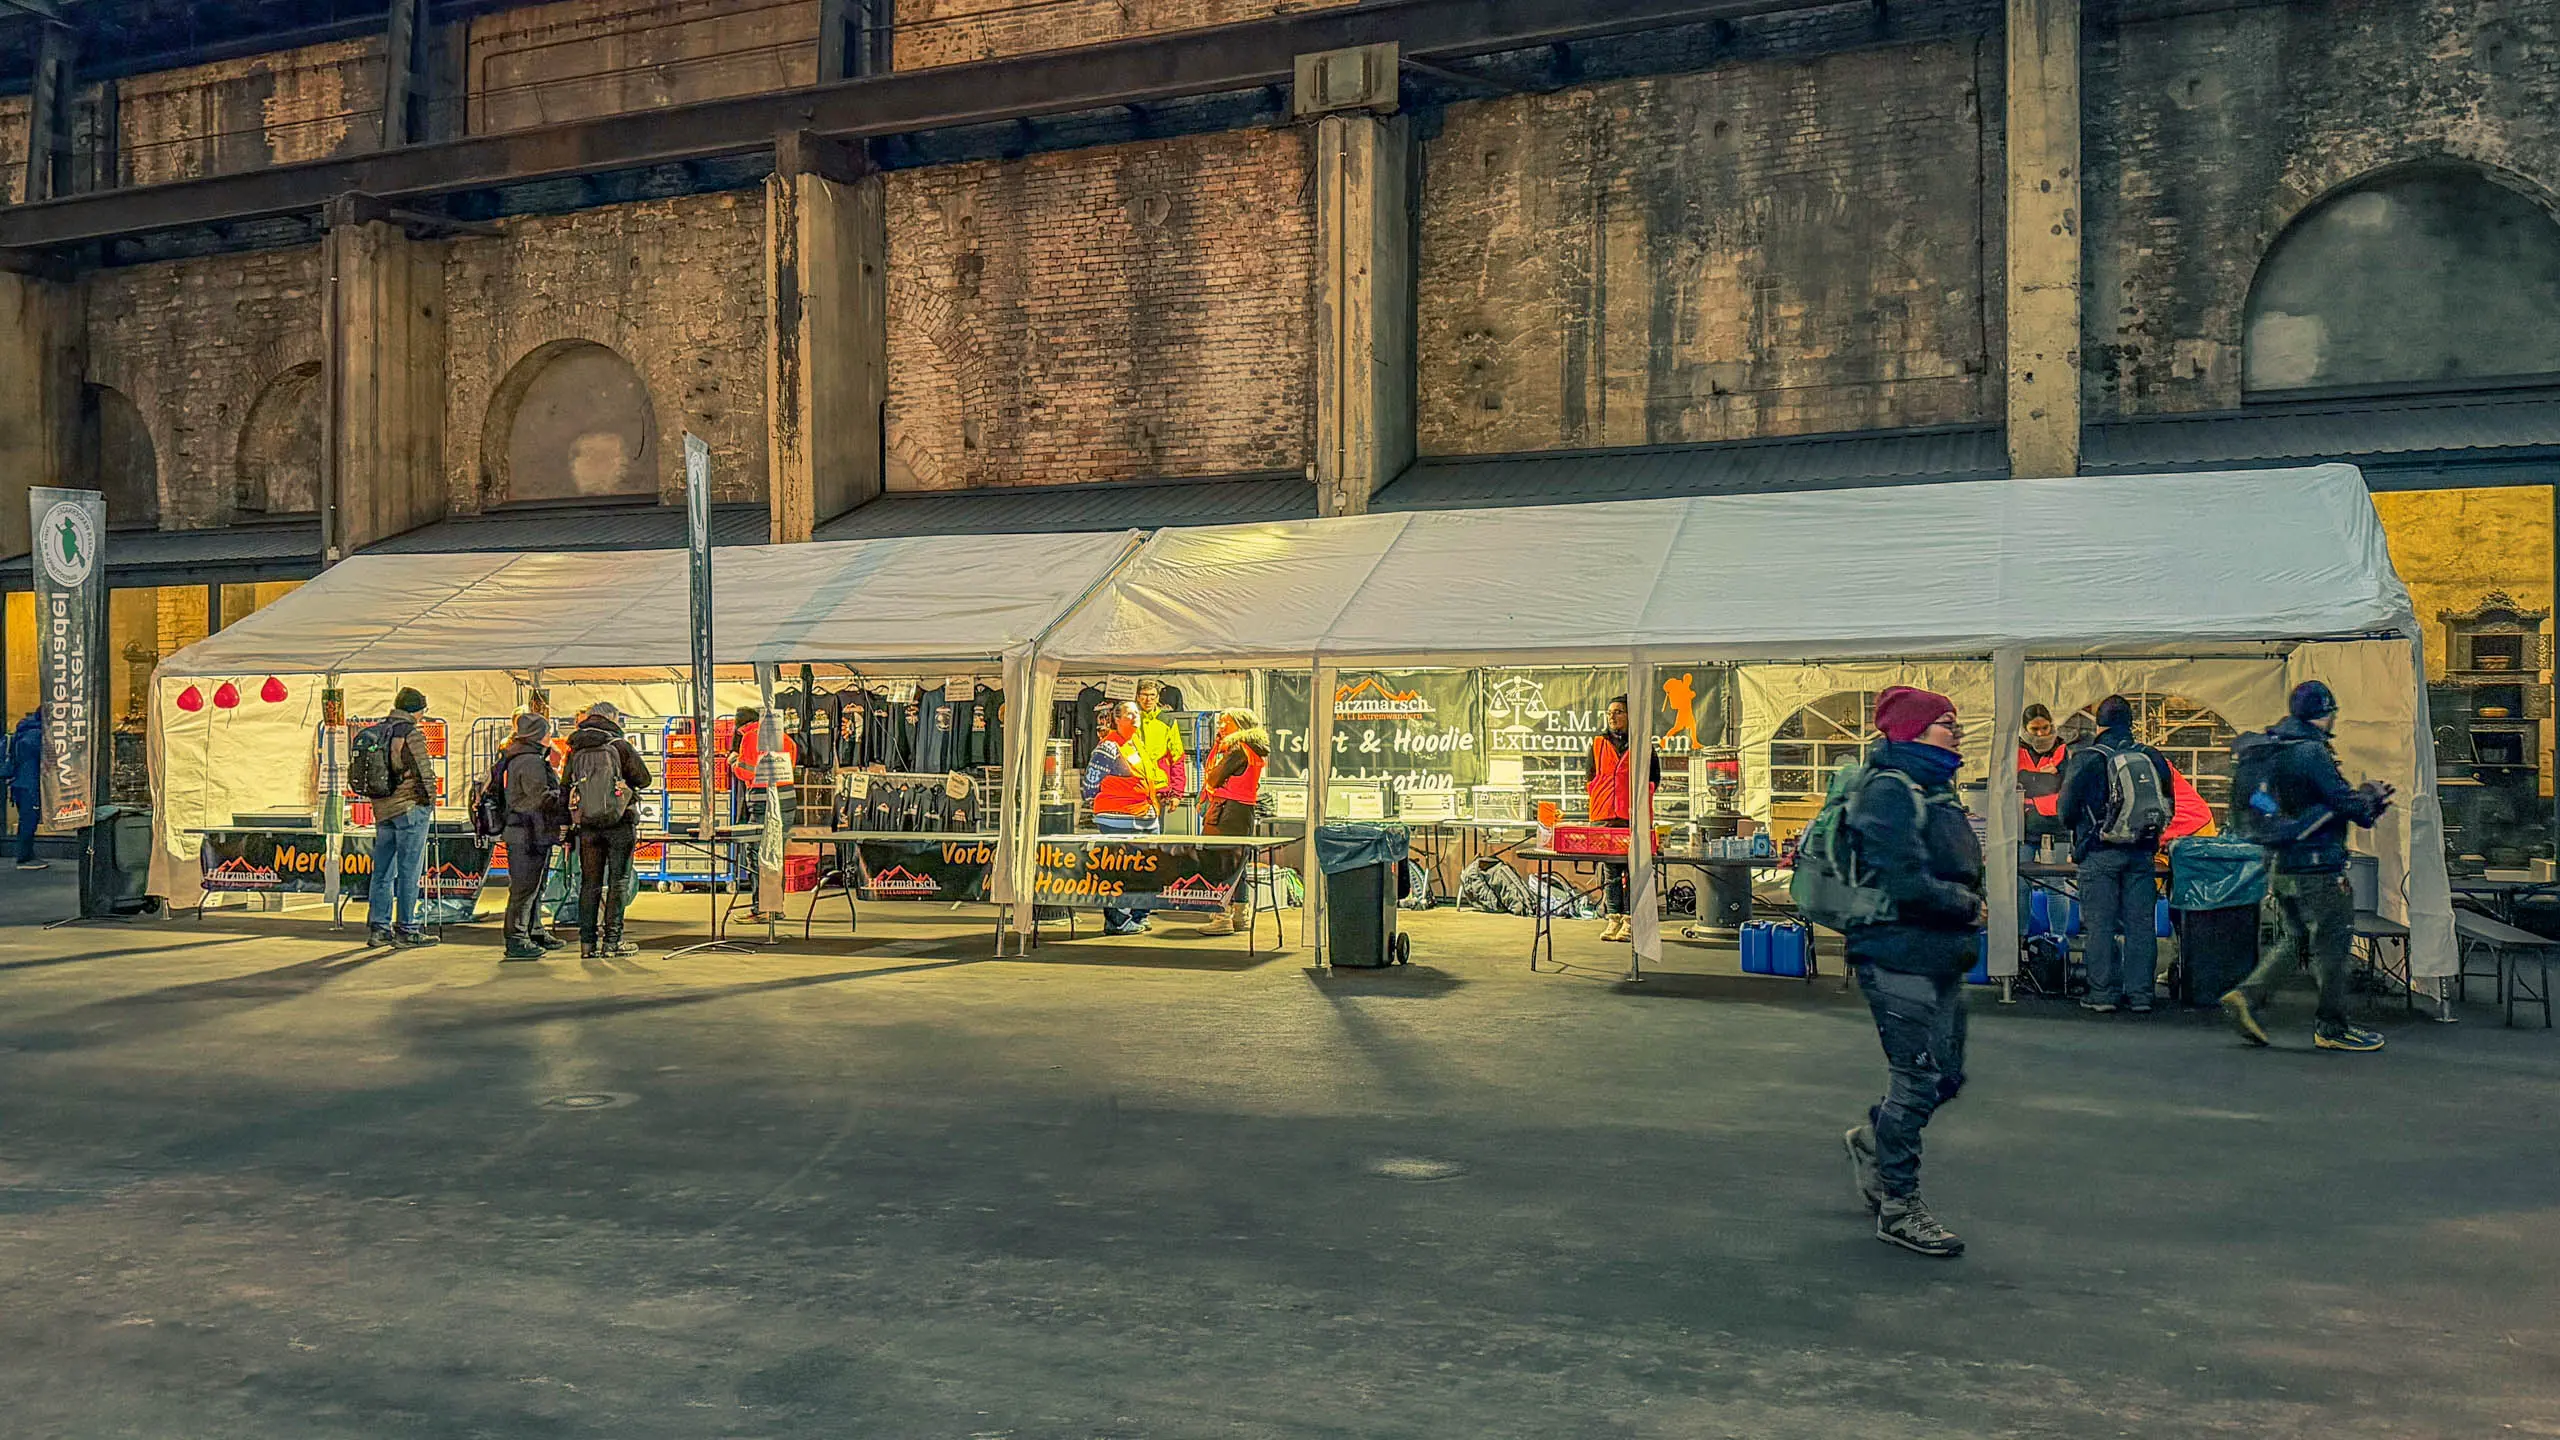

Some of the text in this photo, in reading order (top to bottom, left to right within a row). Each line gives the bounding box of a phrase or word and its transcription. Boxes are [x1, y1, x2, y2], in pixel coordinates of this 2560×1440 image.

[1334, 697, 1428, 712] arzmarsch
[1276, 725, 1474, 753] Tst & Hoodie
[1491, 729, 1690, 751] Extremwern
[274, 843, 375, 875] Mercan
[942, 841, 1158, 872] Vorbllte Shirts
[206, 868, 278, 880] Harzmarsch
[868, 878, 937, 888] Harzmarsch
[1034, 871, 1124, 897] Hoodies
[1163, 886, 1226, 899] Harzmars
